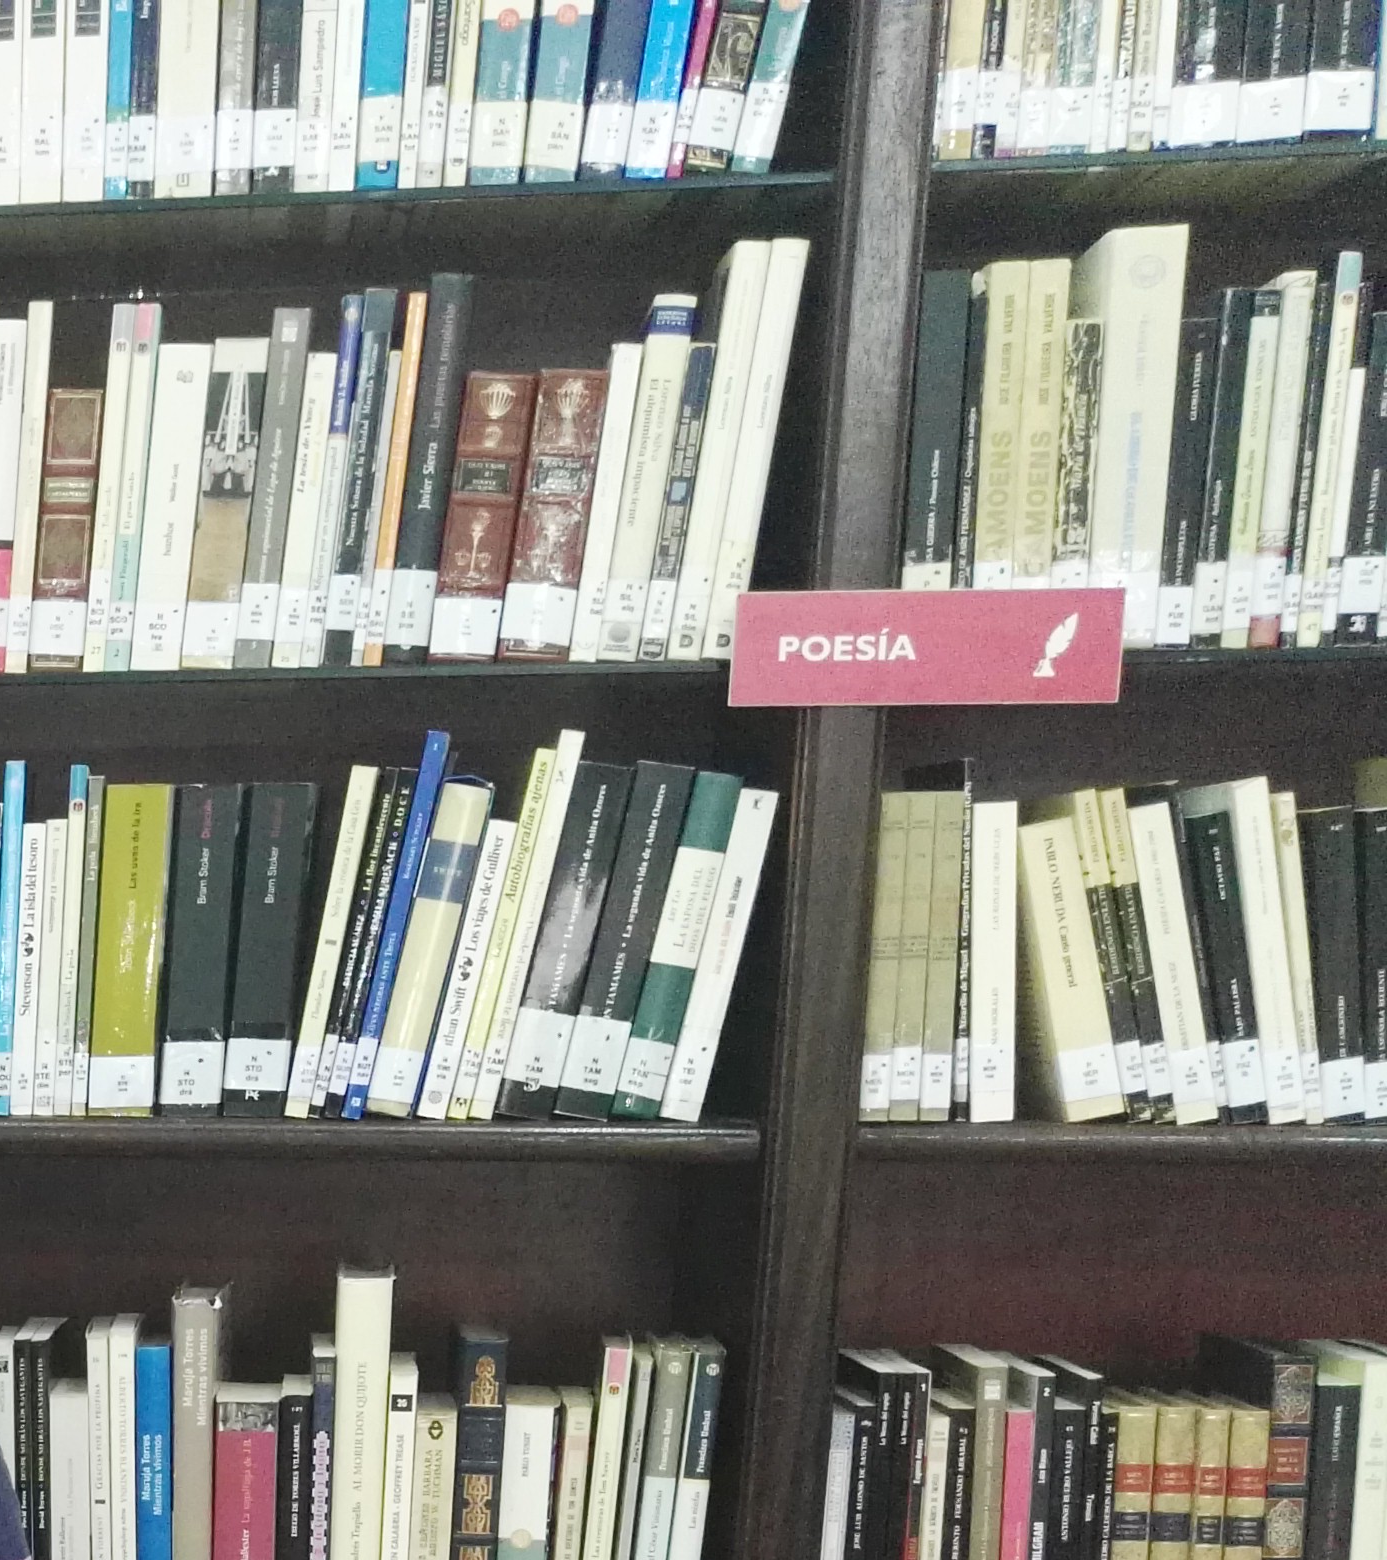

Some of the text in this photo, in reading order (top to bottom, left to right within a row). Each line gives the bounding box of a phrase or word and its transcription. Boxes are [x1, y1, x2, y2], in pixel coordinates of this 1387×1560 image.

[313, 20, 328, 71] Sampedro
[421, 441, 439, 475] Sierra
[417, 477, 436, 511] Javier
[778, 628, 916, 662] POESÍA
[502, 758, 550, 903] Autobiografías ajenas
[640, 848, 651, 860] de
[643, 819, 659, 846] Anita
[199, 847, 211, 876] Stoker
[263, 846, 280, 904] Bram Stoker
[636, 861, 649, 882] vida
[196, 877, 209, 905] Bram
[1043, 837, 1077, 988] PABLO NERUDA Canto general
[19, 838, 39, 1017] Stevenson La isla del tesoro
[449, 835, 505, 1016] Swift Los viajes de Gulliver
[181, 1328, 196, 1407] Maruja Torres
[196, 1328, 208, 1426] Mientras vivimos
[353, 1361, 368, 1492] AL MORIR DON QUIJOTE
[141, 1434, 152, 1501] Maruja Torres
[152, 1434, 163, 1516] Mientras vivimos
